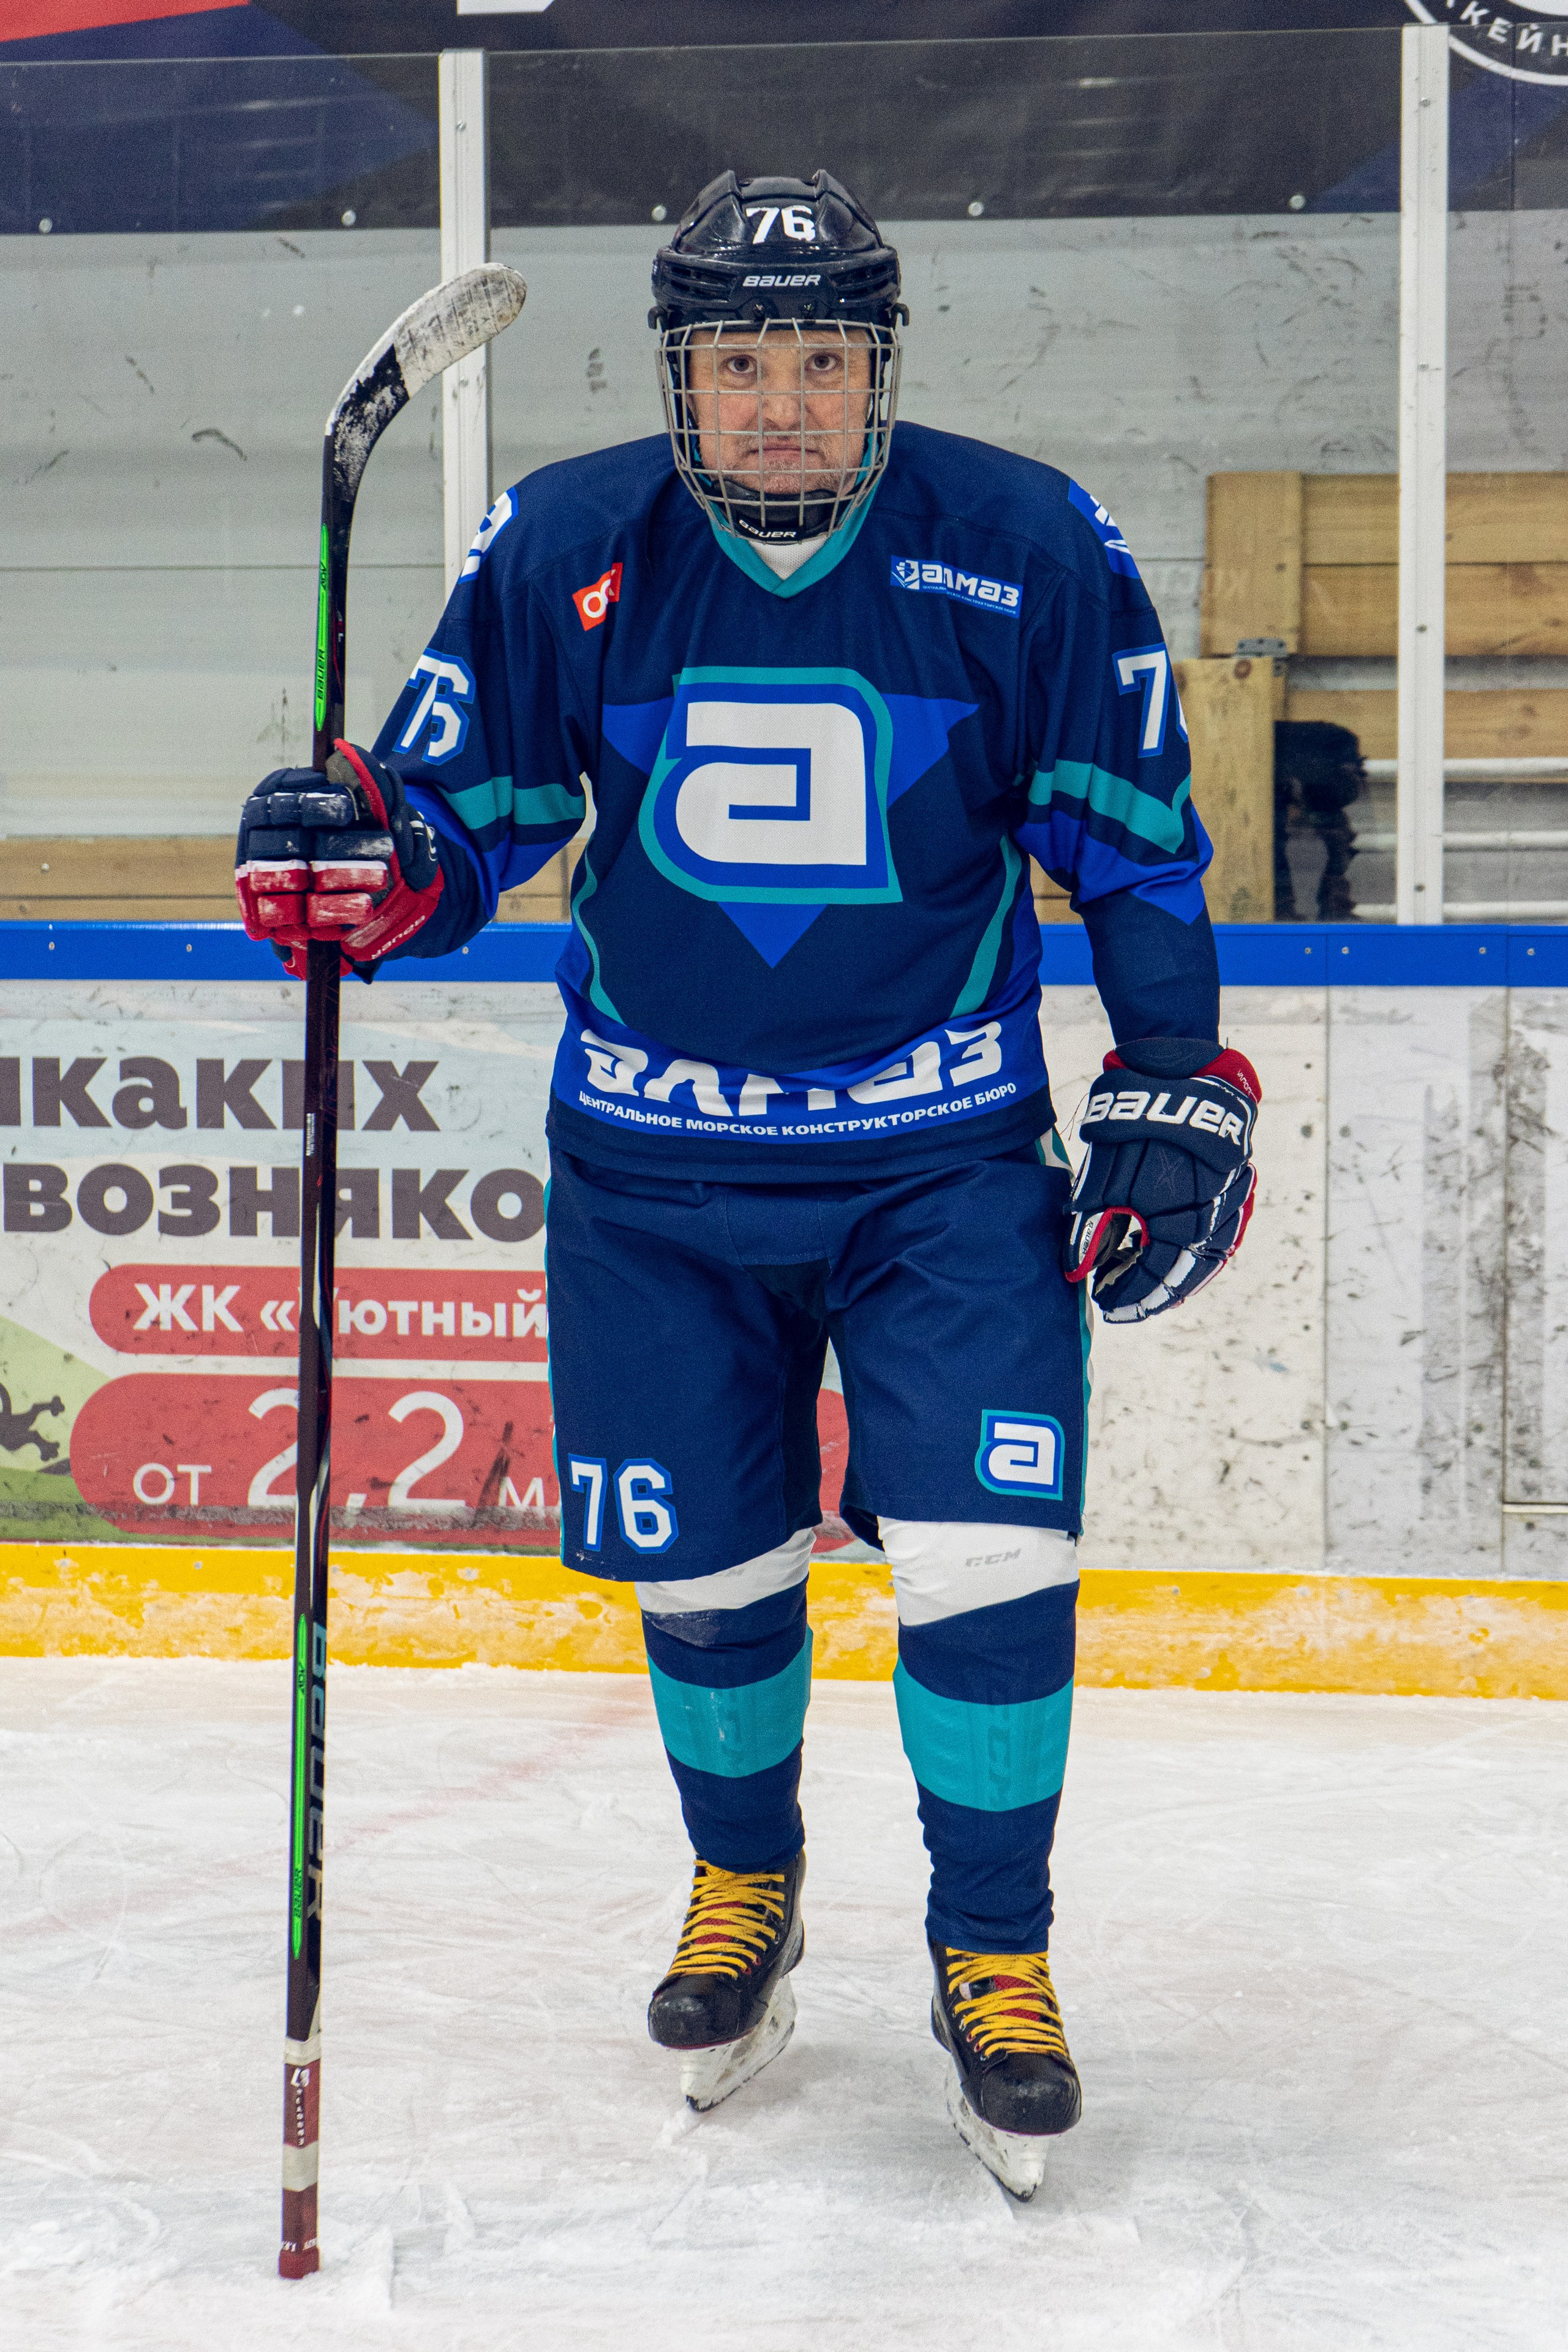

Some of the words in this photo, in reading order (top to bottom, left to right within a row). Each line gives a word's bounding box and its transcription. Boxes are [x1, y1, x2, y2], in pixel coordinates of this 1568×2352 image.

[745, 205, 816, 244] 76
[742, 274, 821, 287] BAUER
[739, 519, 796, 538] BAUER
[394, 649, 474, 763] 76
[1113, 644, 1188, 756] 7
[0, 1056, 441, 1132] каких
[579, 1090, 682, 1129] ЦЕНТРАЛЬНОЕ
[686, 1118, 778, 1136] МОРСКОЕ
[782, 1099, 973, 1136] КОНСТРУКТОРСКОЕ
[976, 1083, 1017, 1106] БЮРО
[1081, 1090, 1245, 1147] BAUER
[133, 1284, 243, 1332] ЖК
[260, 1288, 548, 1338] «ютный
[570, 1456, 676, 1551] 76
